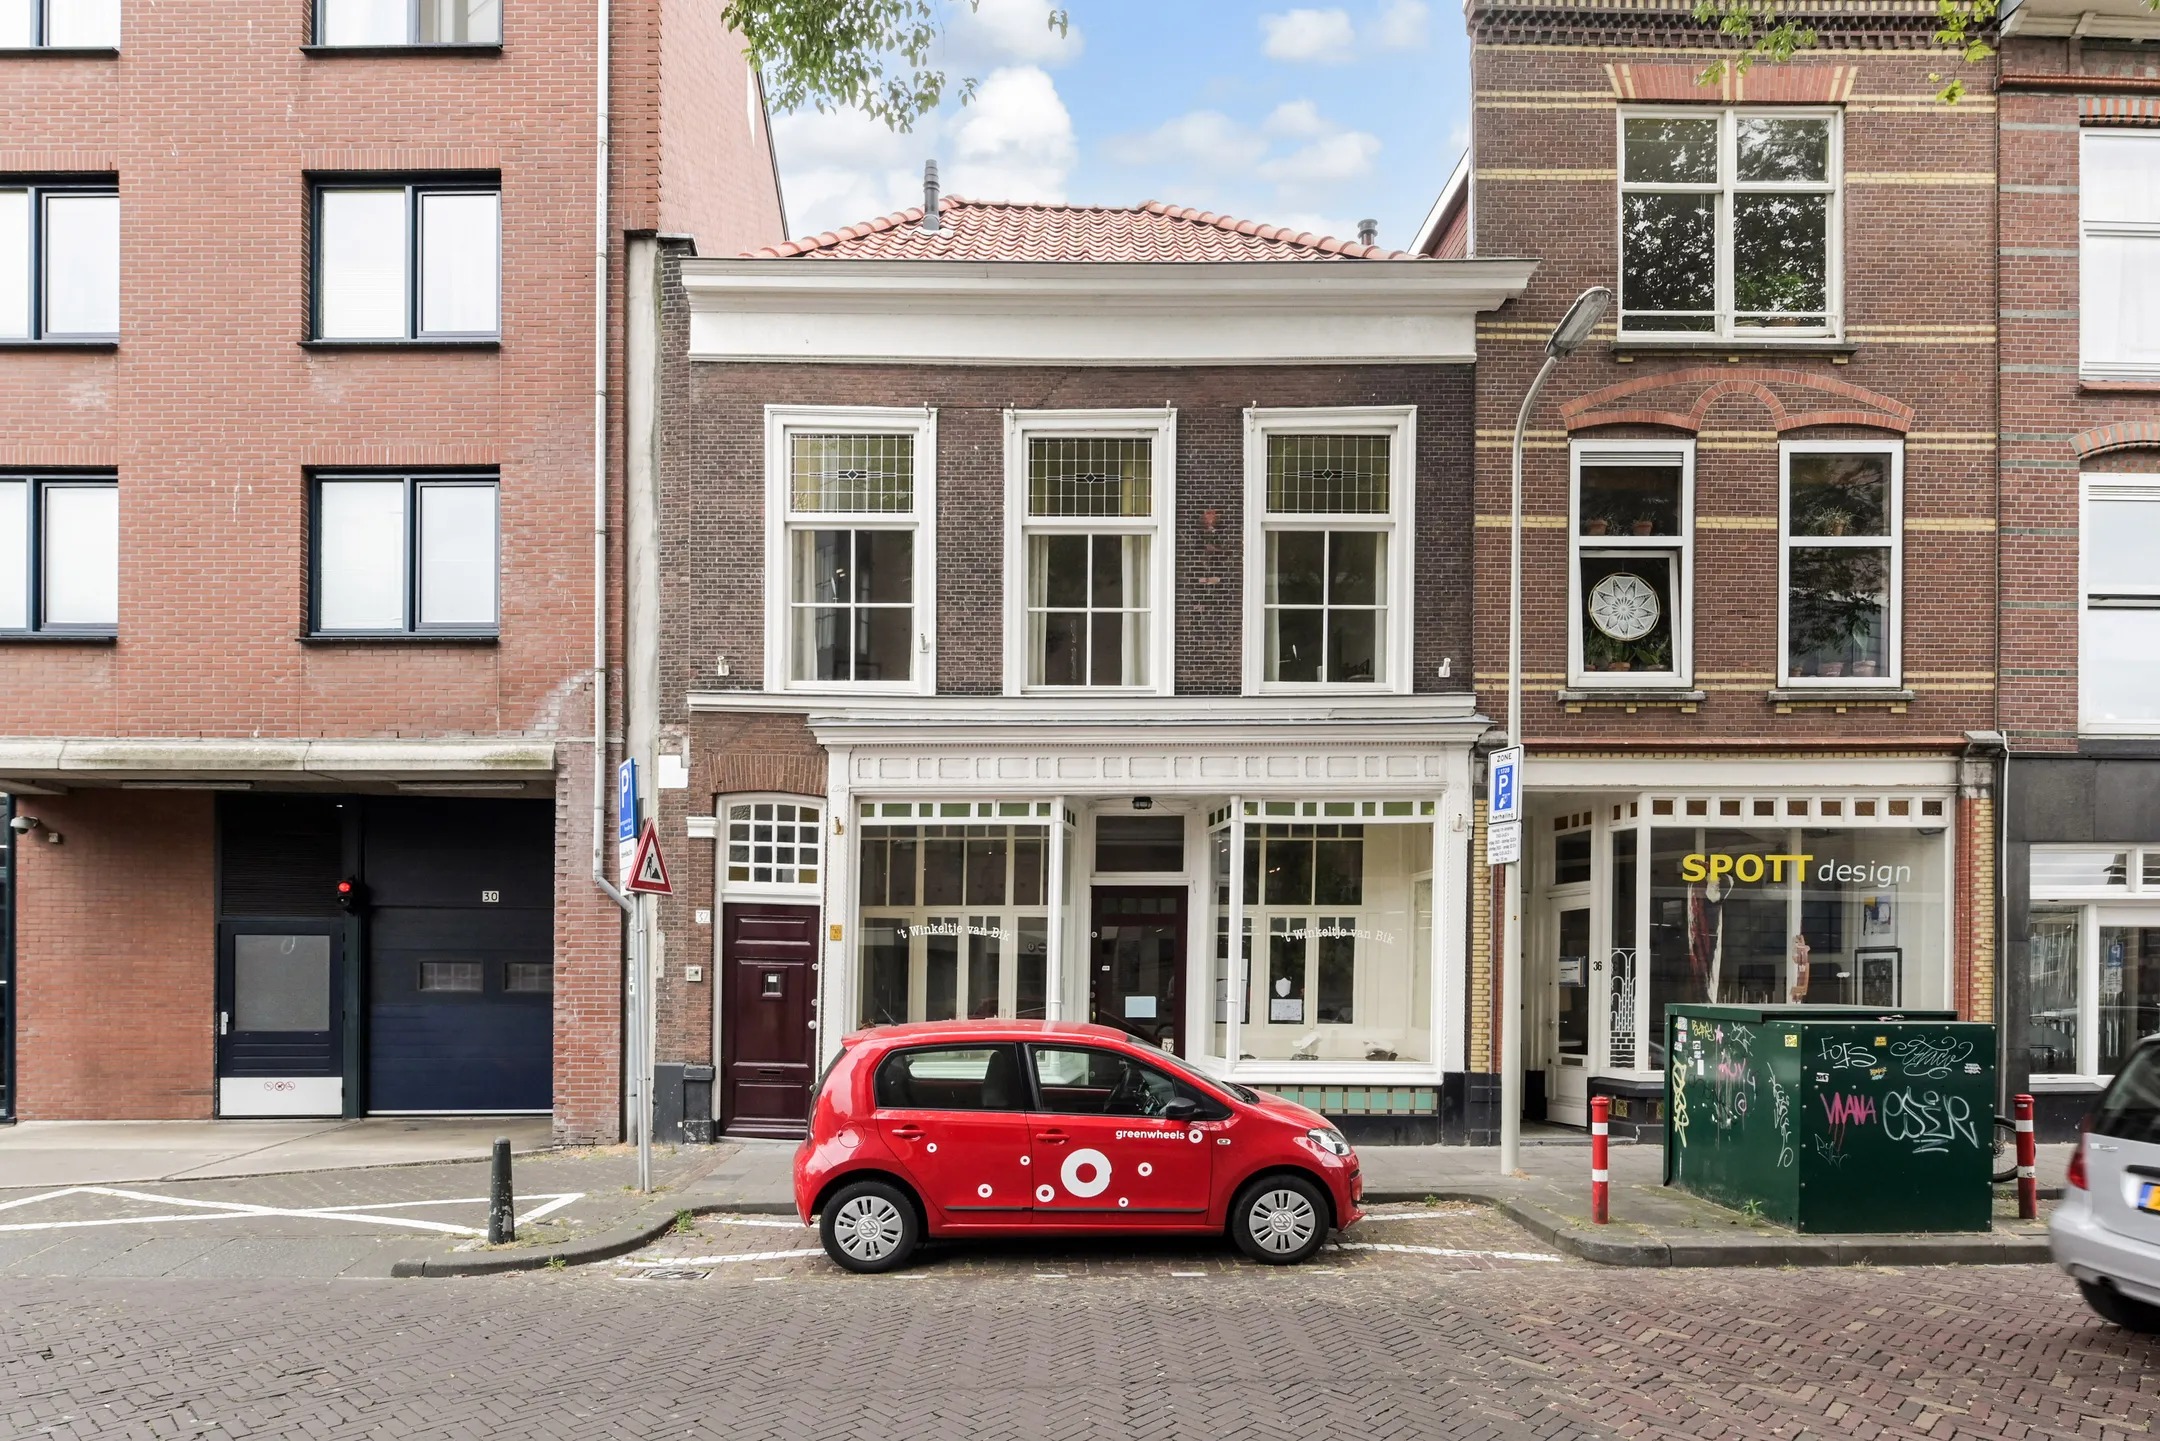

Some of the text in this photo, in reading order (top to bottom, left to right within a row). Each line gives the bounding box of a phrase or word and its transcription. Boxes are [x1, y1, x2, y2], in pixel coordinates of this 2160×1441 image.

[1497, 752, 1512, 762] ZONE
[621, 769, 629, 808] P
[1499, 774, 1508, 795] P
[1682, 854, 1911, 888] SPOTT design
[484, 891, 498, 901] 30
[909, 923, 963, 936] Winkeltje
[967, 926, 987, 936] van
[991, 926, 1010, 941] Bik
[1293, 926, 1347, 940] Winkeltje
[1351, 929, 1371, 939] van
[1375, 930, 1395, 945] Bik
[1593, 961, 1602, 971] 36
[1115, 1129, 1185, 1139] greenwheels
